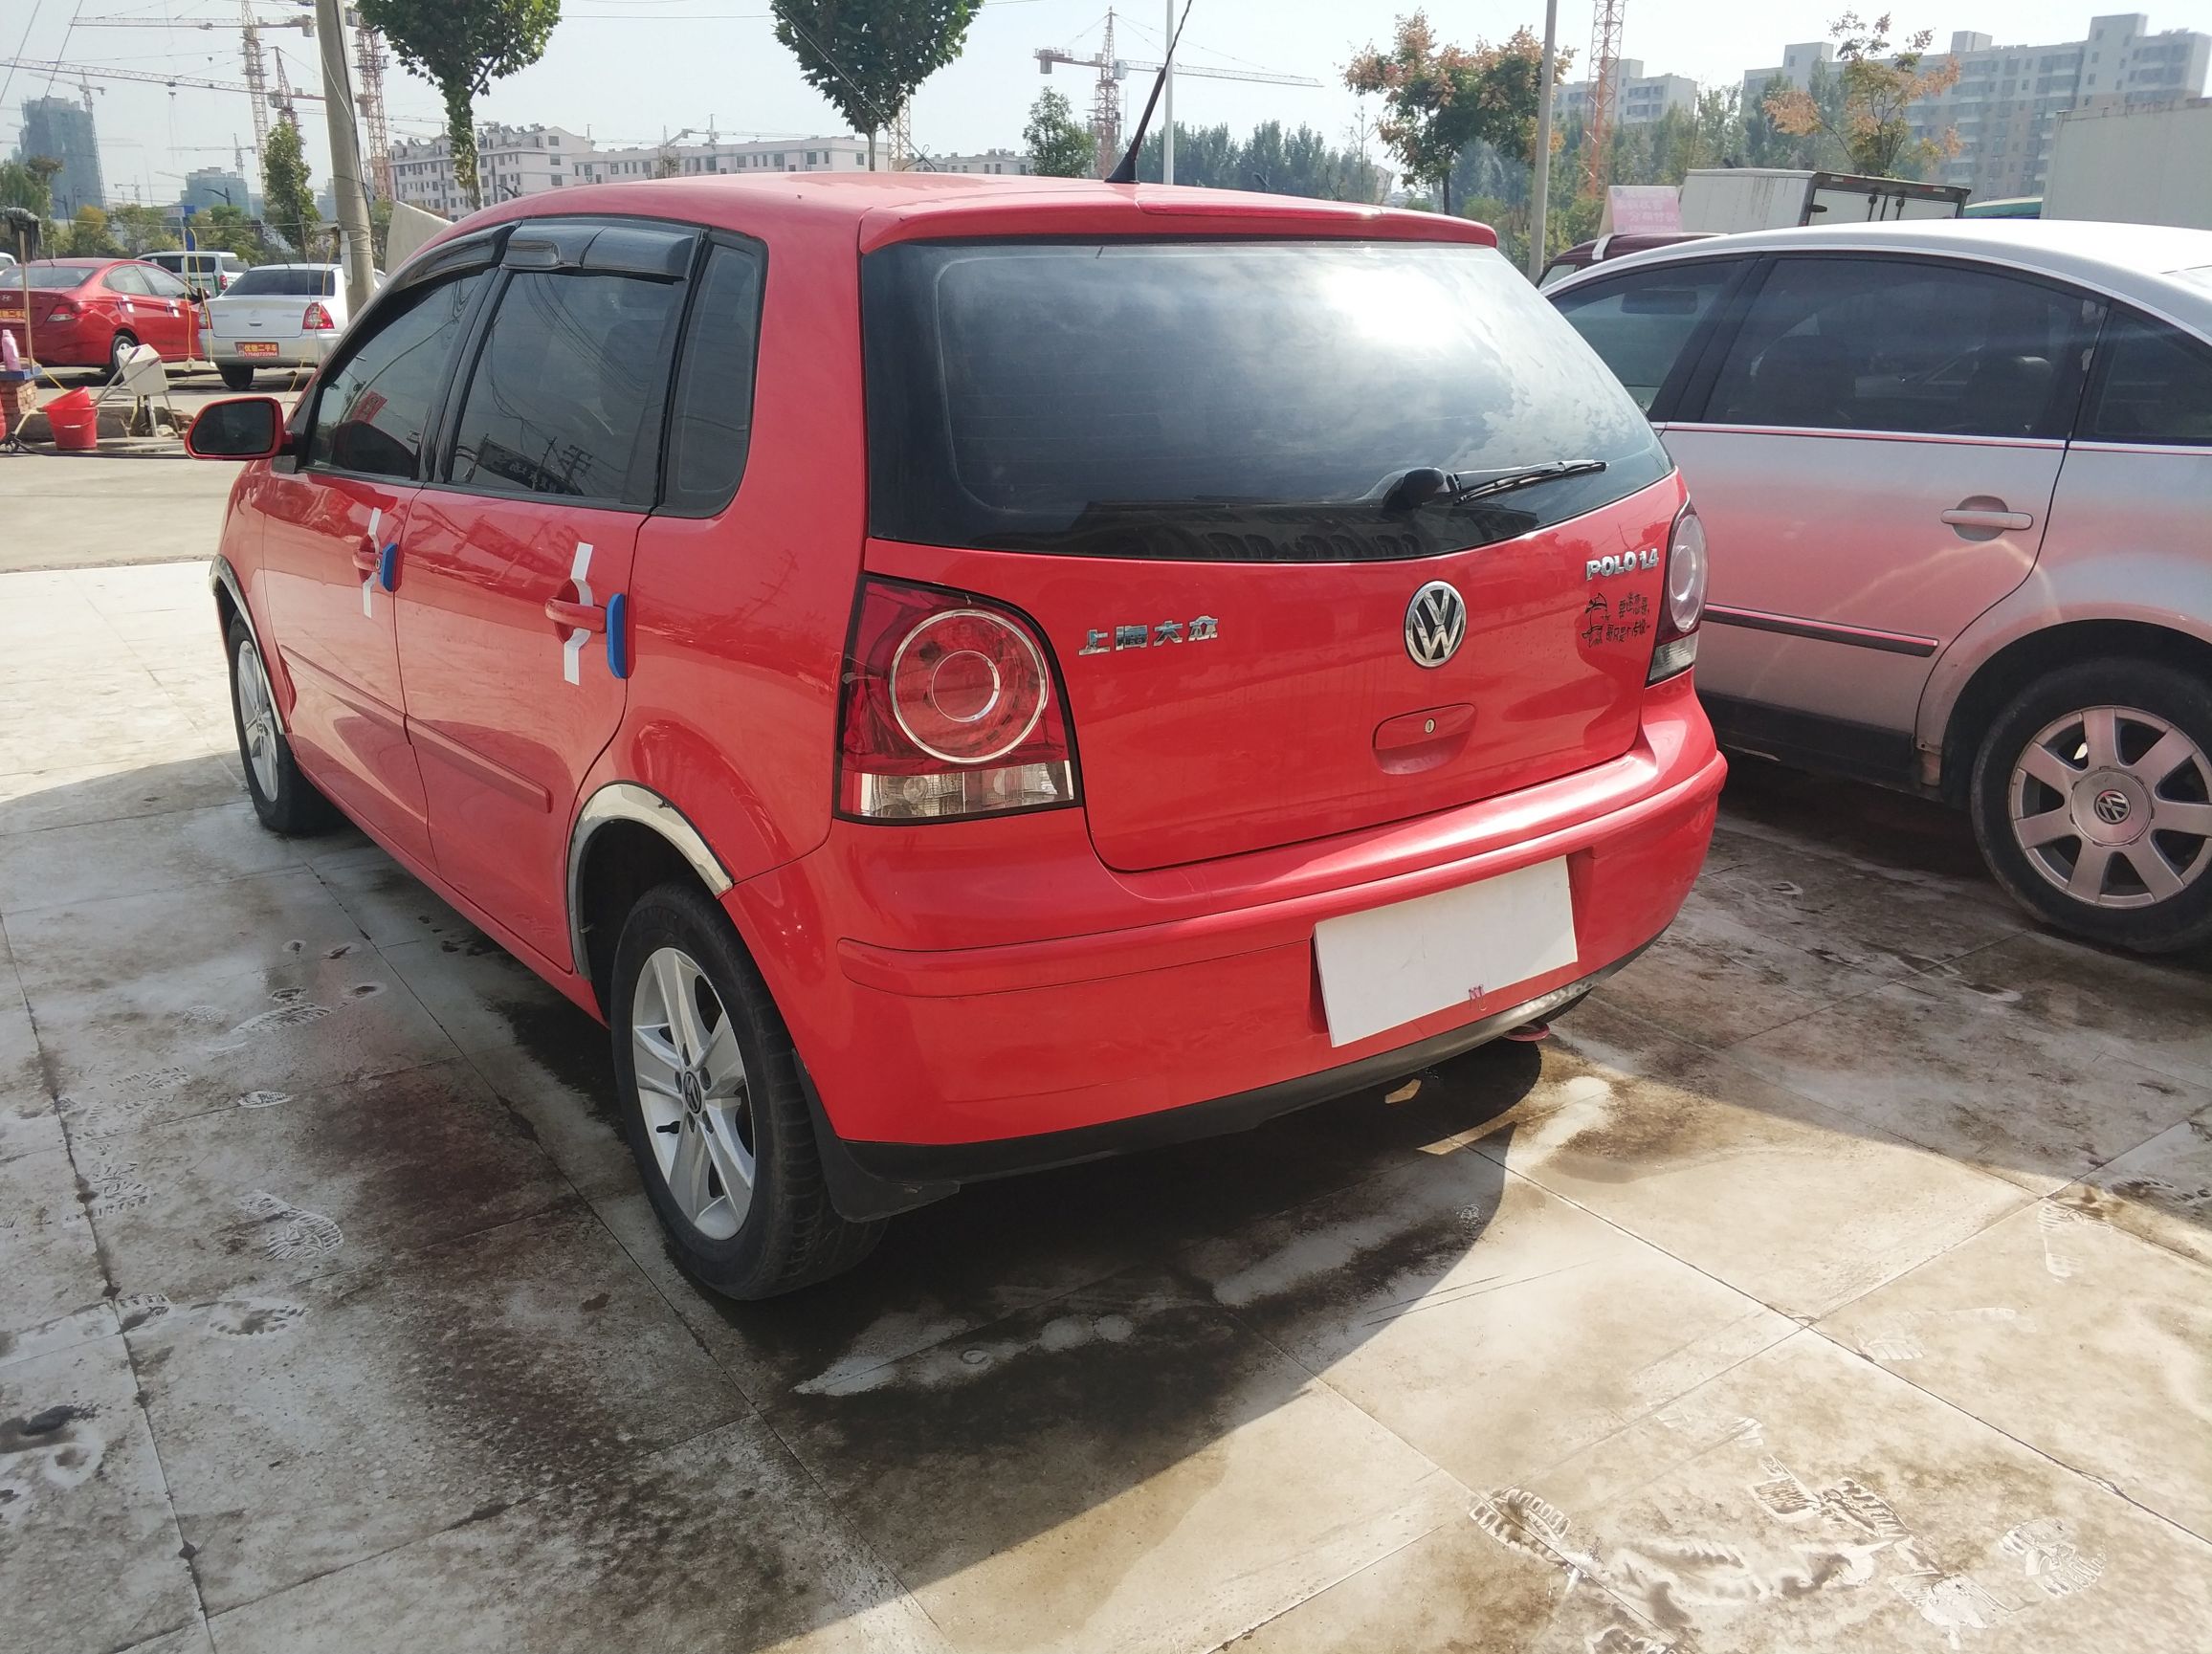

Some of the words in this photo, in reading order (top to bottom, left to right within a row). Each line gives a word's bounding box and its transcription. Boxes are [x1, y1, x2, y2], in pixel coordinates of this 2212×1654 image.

[1585, 551, 1637, 582] POLO
[1078, 615, 1219, 656] 上海大众
